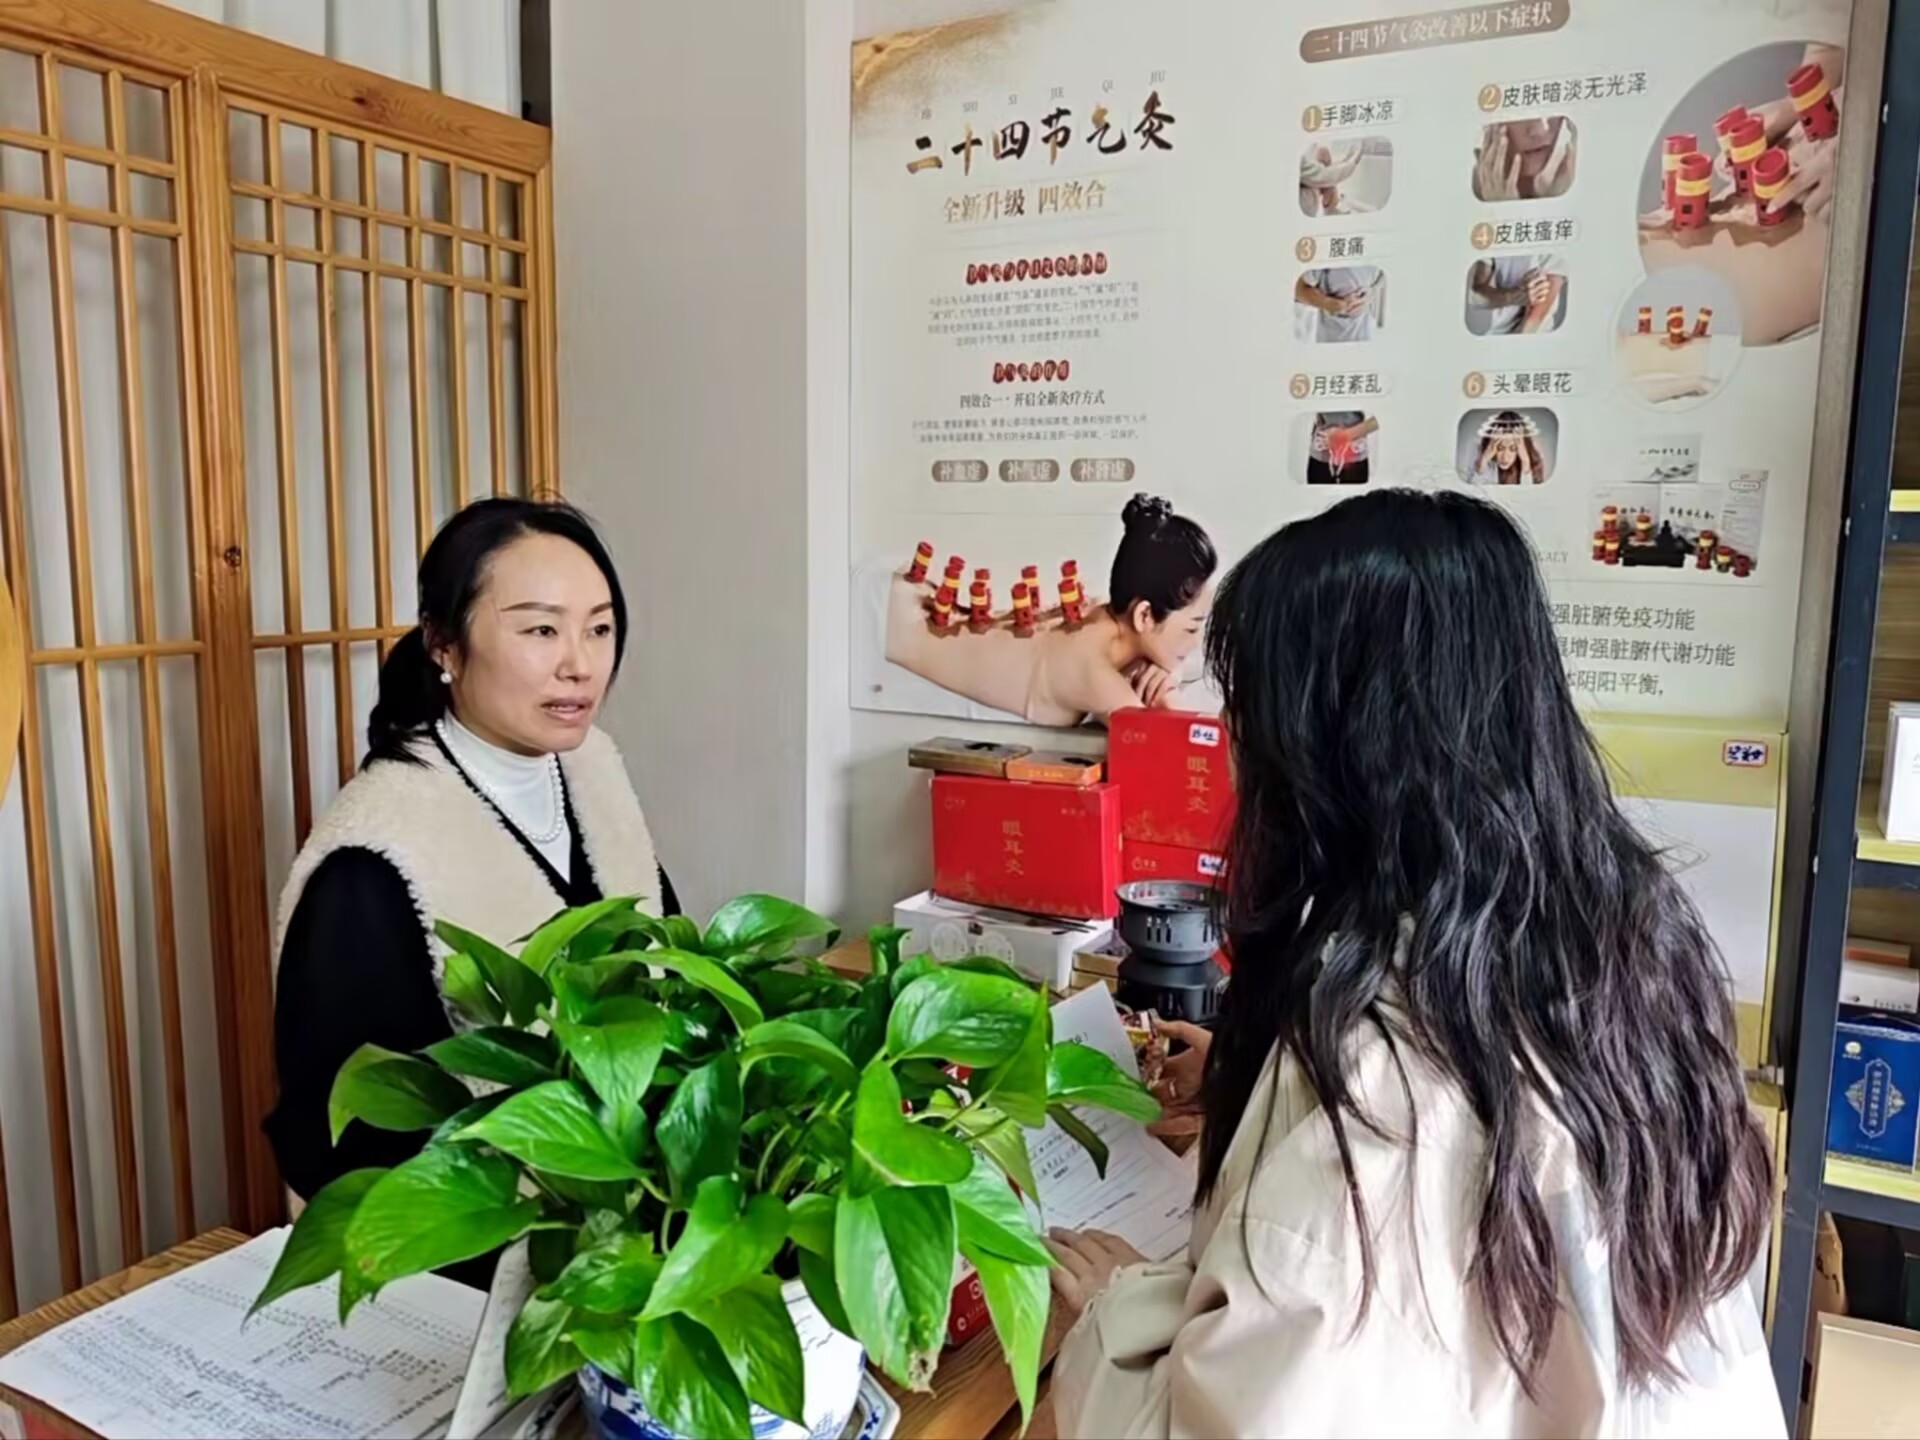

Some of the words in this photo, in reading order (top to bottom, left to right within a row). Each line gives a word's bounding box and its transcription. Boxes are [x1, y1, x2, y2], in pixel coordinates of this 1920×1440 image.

[1312, 2, 1553, 55] 二十四节气灸改善以下症状
[1501, 71, 1648, 108] 皮肤暗淡无光泽
[1321, 100, 1394, 127] 手脚冰凉
[906, 91, 1176, 176] 二十四节气灸
[944, 188, 1025, 224] 全新升级
[1494, 219, 1574, 245] 皮肤瘙痒
[1328, 236, 1364, 258] 腹痛
[1311, 374, 1383, 396] 月经紊乱
[1493, 372, 1573, 395] 头晕眼花
